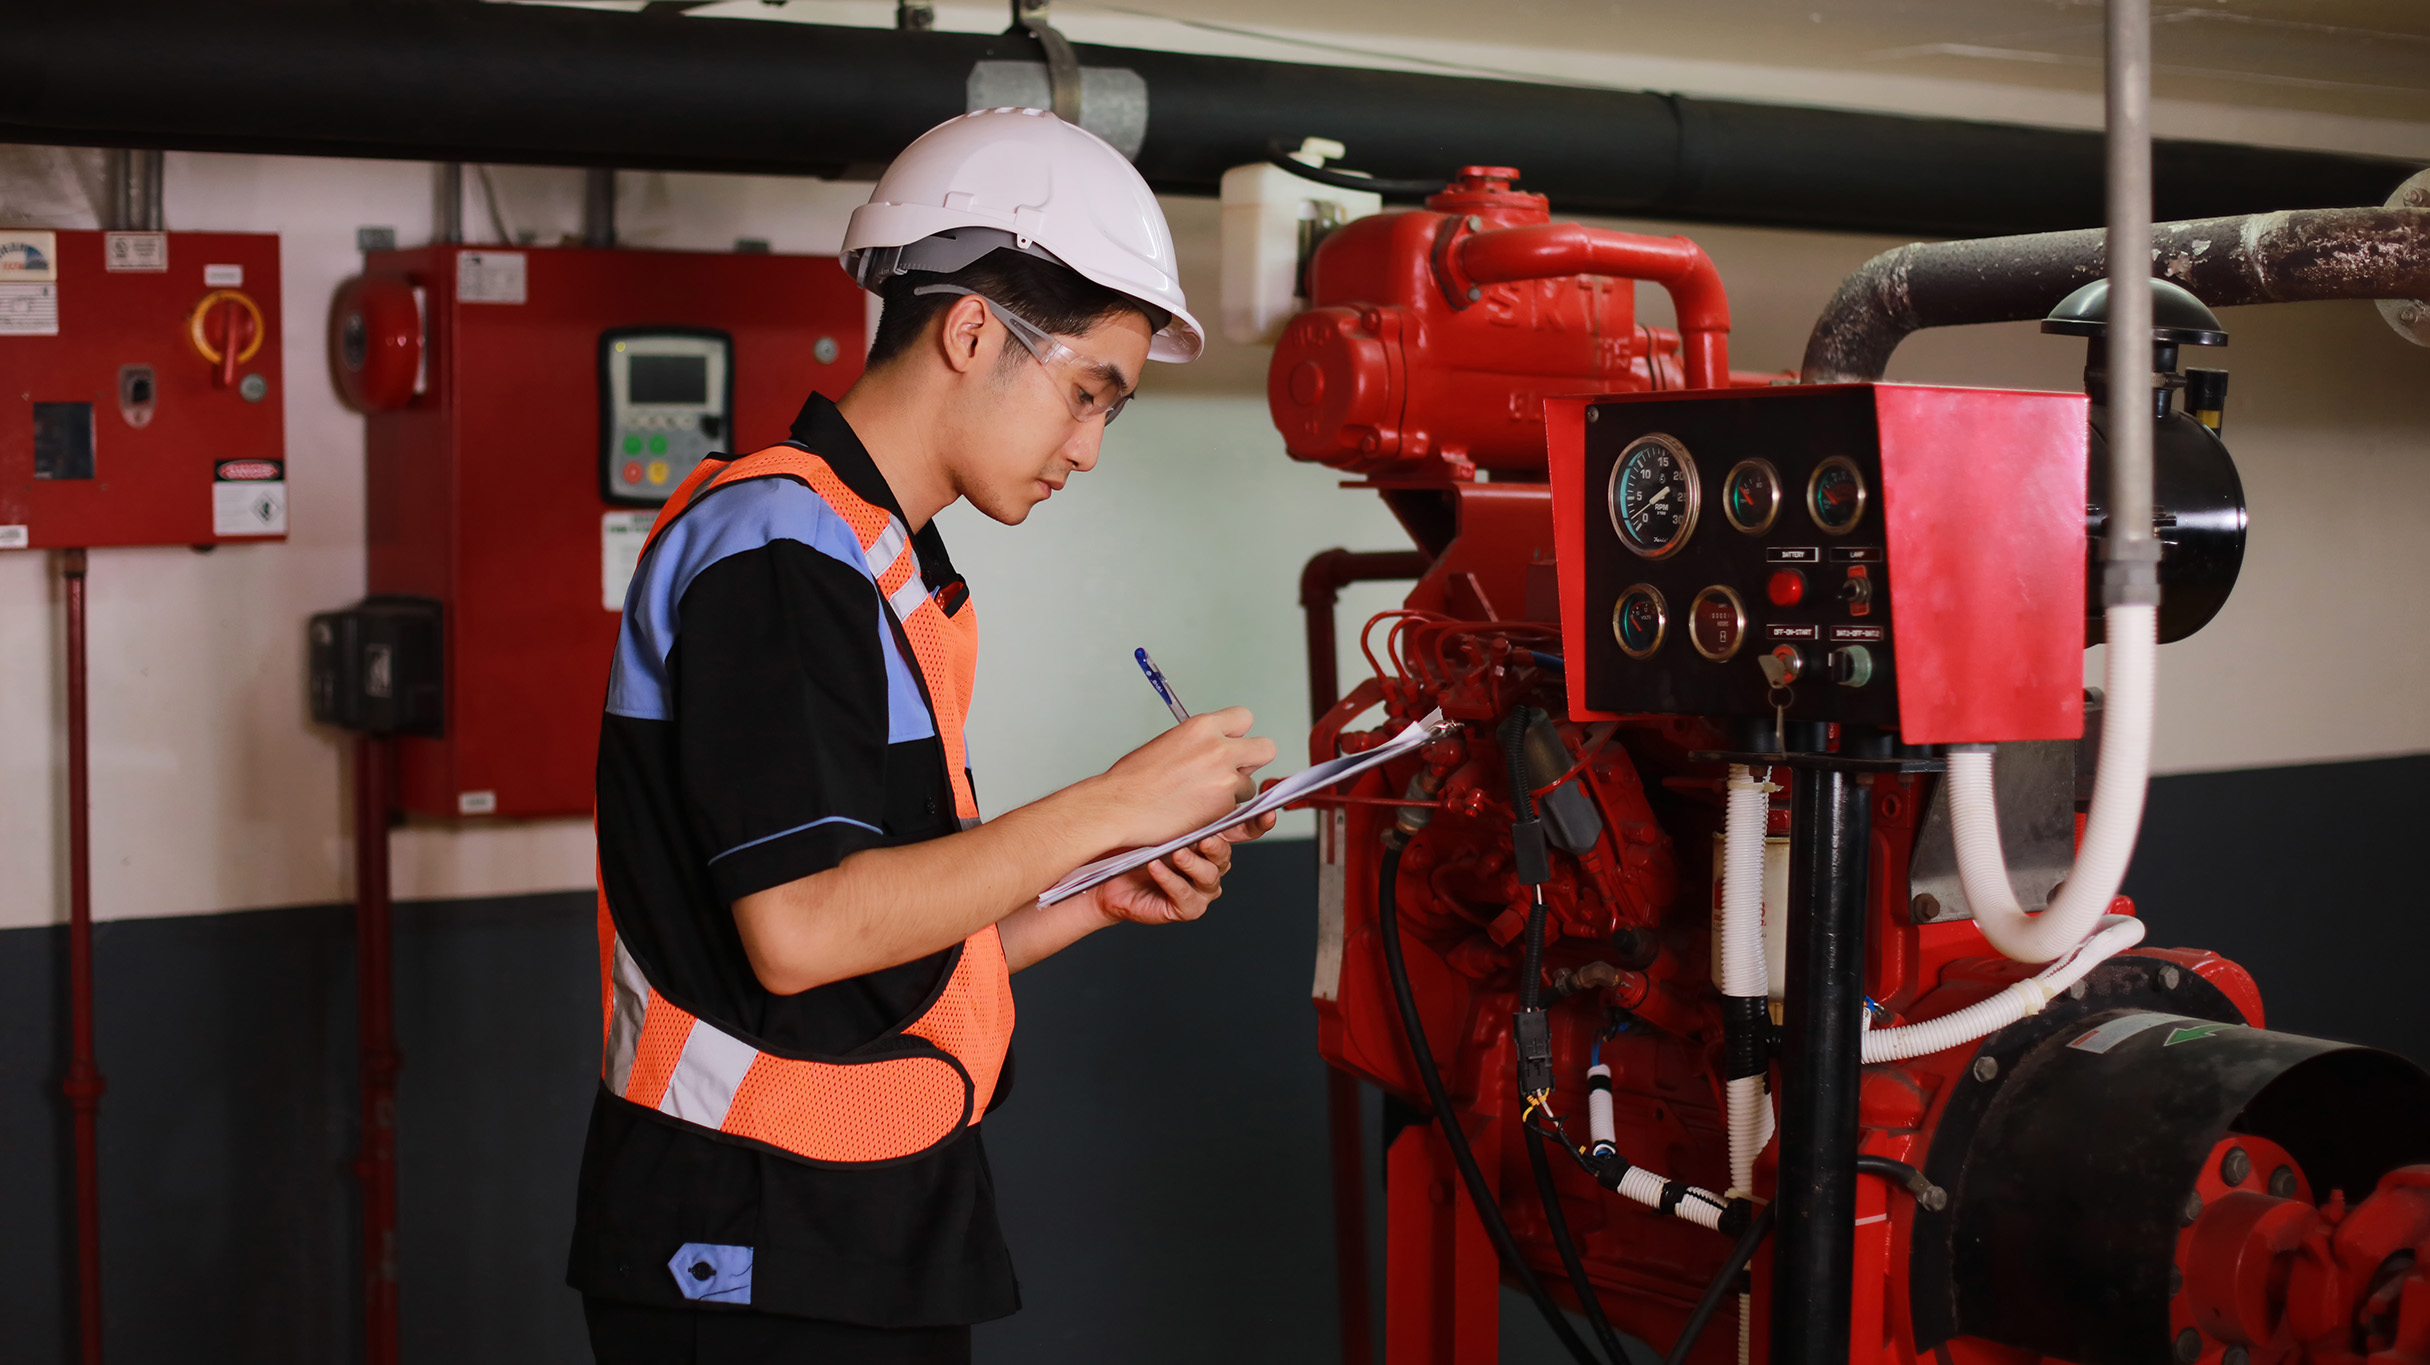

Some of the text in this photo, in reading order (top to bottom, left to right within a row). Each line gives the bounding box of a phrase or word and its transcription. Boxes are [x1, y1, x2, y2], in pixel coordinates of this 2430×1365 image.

[1657, 456, 1670, 467] 15
[1640, 469, 1652, 480] 10
[1673, 471, 1685, 481] 20
[1636, 491, 1643, 501] 5
[1654, 503, 1669, 511] RPM
[1642, 513, 1649, 523] 0
[1672, 514, 1684, 525] 30
